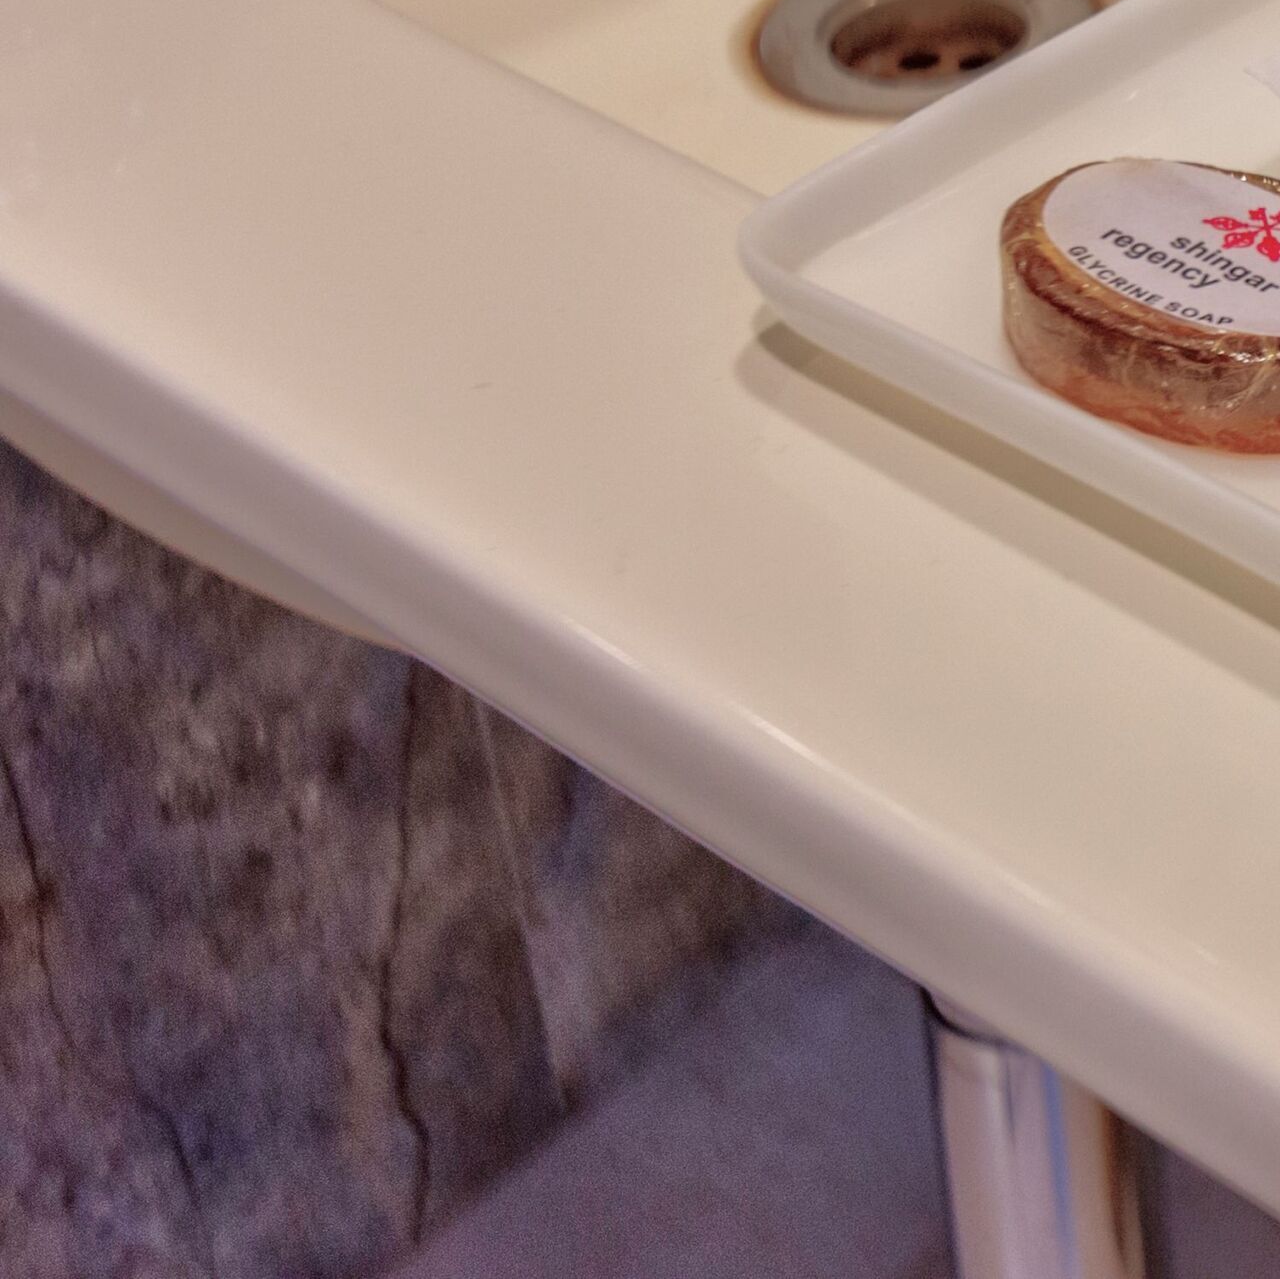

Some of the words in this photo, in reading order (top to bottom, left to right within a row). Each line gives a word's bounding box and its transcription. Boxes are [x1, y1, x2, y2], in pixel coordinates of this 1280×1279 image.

[1067, 244, 1165, 305] GLYCRINE
[1164, 300, 1236, 326] SOAP
[1100, 227, 1223, 290] regency
[1170, 234, 1280, 294] shingar
